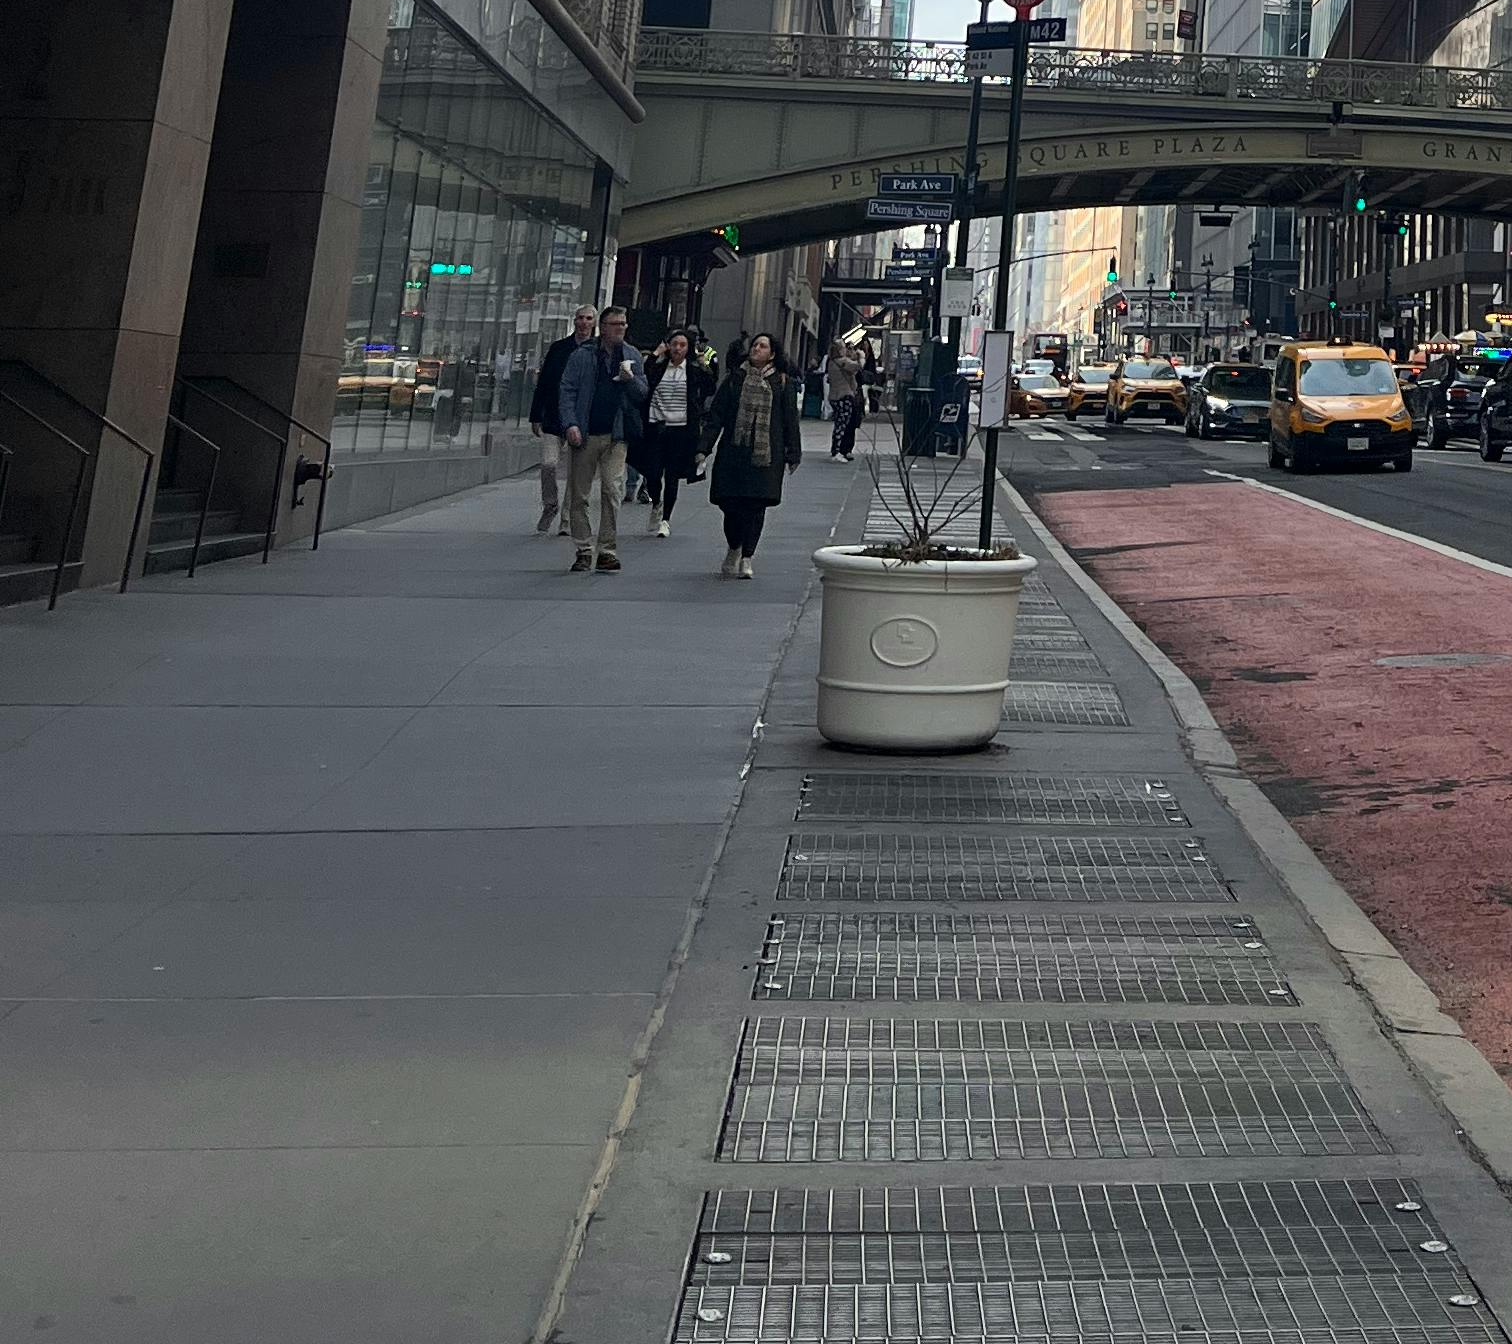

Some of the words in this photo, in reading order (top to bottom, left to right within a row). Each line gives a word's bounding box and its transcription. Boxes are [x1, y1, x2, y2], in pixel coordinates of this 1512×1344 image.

[1030, 21, 1060, 40] M42
[831, 151, 989, 191] PERSHING
[1017, 140, 1130, 167] QUARE
[1153, 135, 1248, 156] PLAZA
[892, 179, 918, 190] Park
[920, 179, 942, 190] Ave
[870, 202, 914, 217] Pershing
[916, 205, 949, 219] Square
[900, 251, 916, 259] Park
